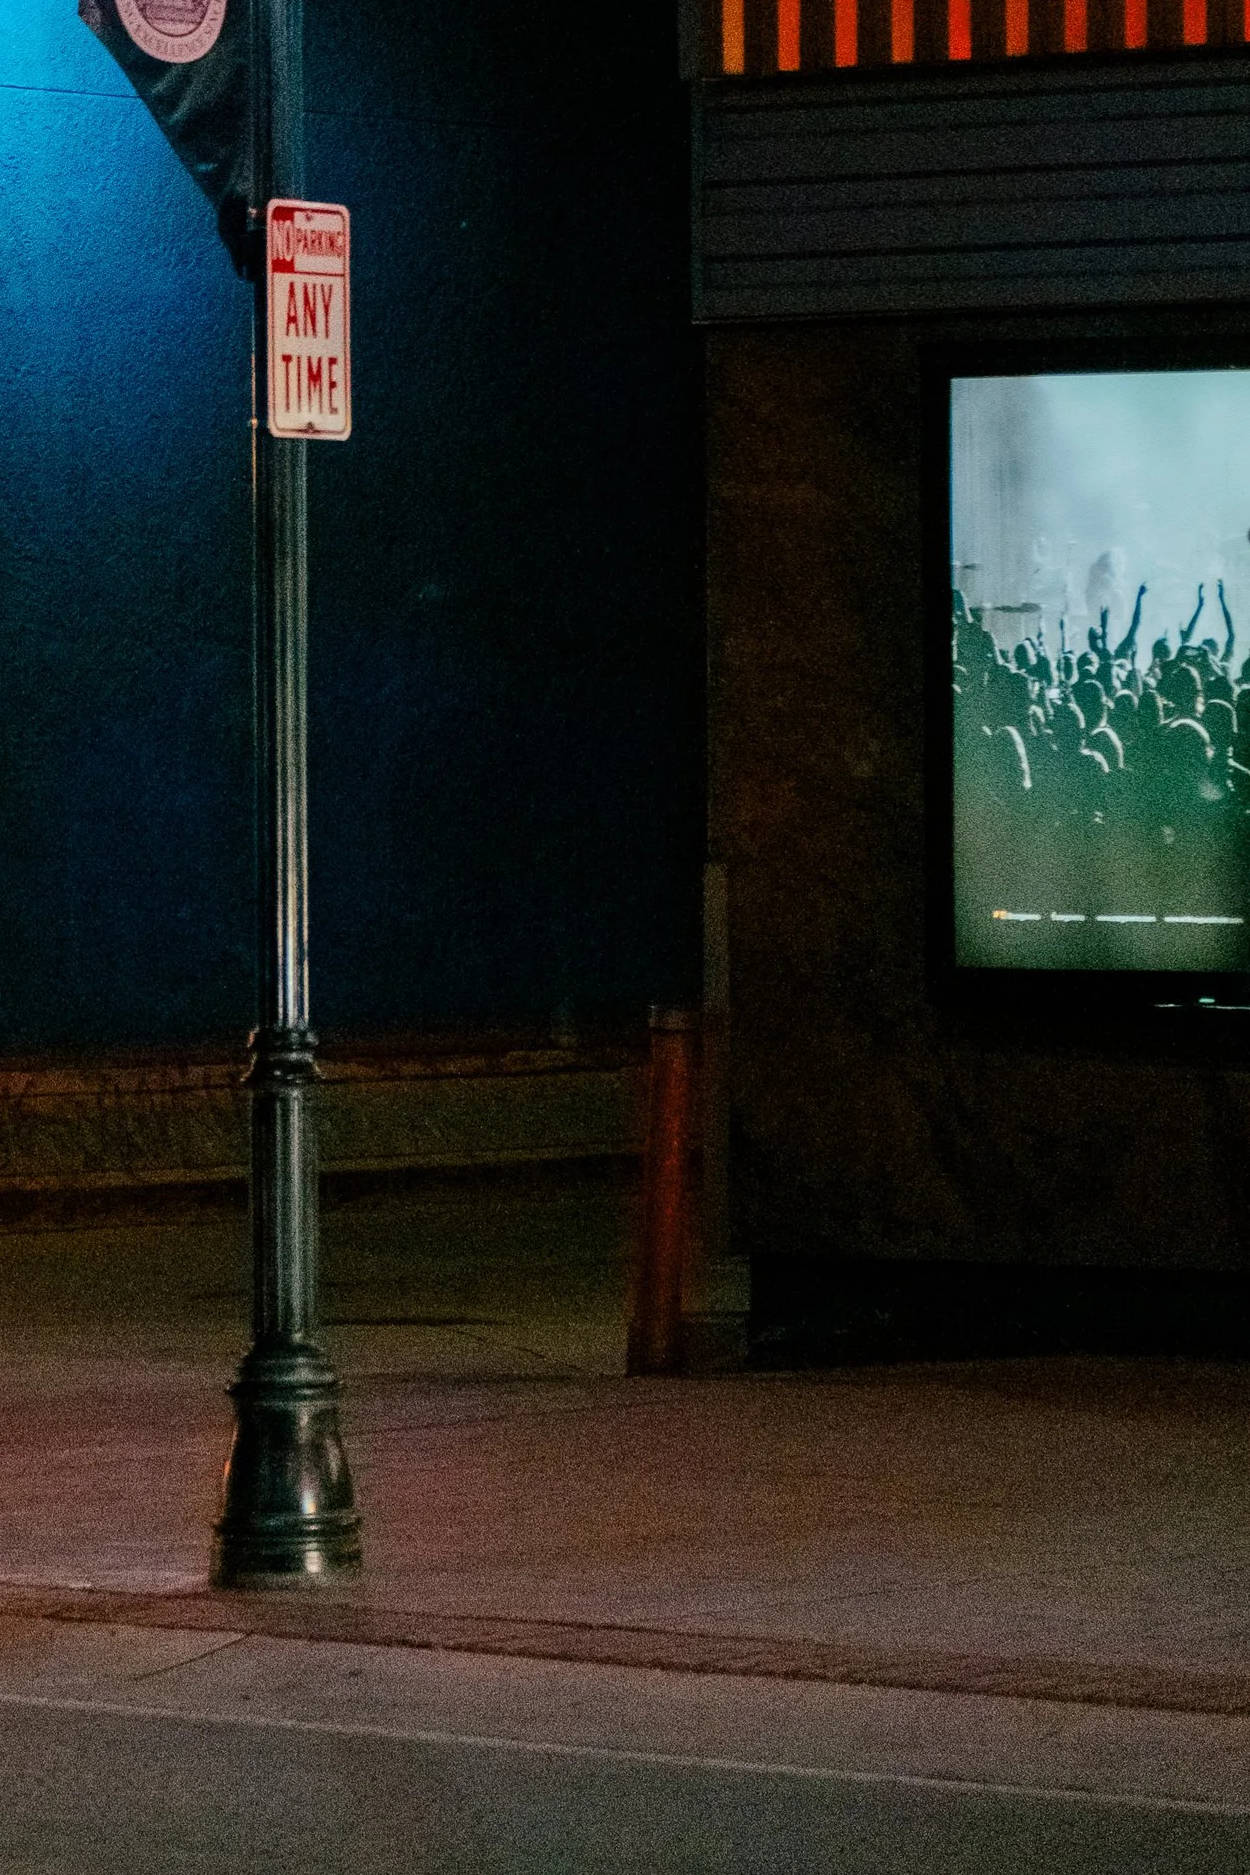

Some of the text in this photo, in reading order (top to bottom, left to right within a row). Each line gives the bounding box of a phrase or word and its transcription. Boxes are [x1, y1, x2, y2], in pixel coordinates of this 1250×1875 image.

[271, 220, 345, 262] NO PARKING
[286, 281, 333, 339] ANY
[282, 354, 338, 415] TIME
